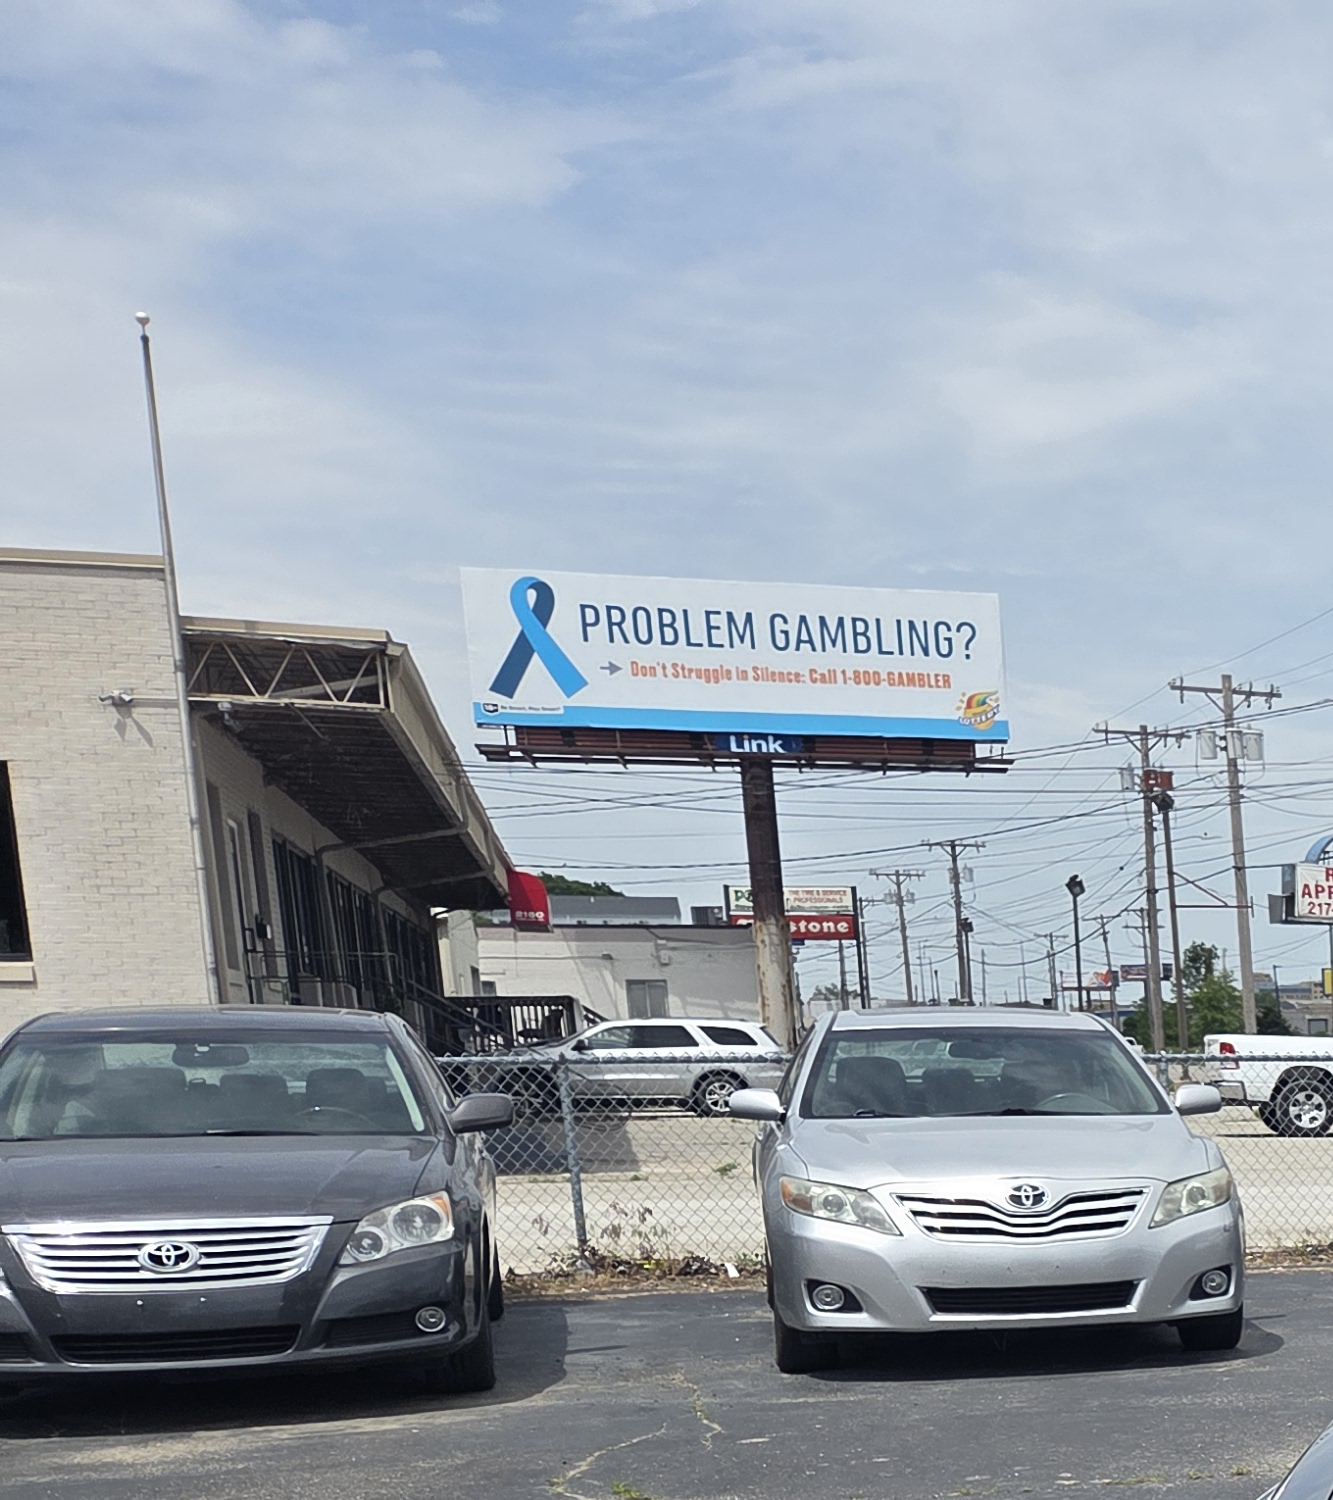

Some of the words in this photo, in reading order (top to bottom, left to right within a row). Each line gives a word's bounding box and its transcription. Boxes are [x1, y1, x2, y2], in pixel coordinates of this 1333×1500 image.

[579, 603, 756, 650] PROBLEM
[769, 612, 977, 660] GAMBLING?
[630, 660, 668, 678] Don't
[671, 662, 732, 685] Struggle
[808, 668, 838, 684] Call
[840, 669, 952, 689] 1-800-GAMBLER
[729, 734, 788, 753] Link
